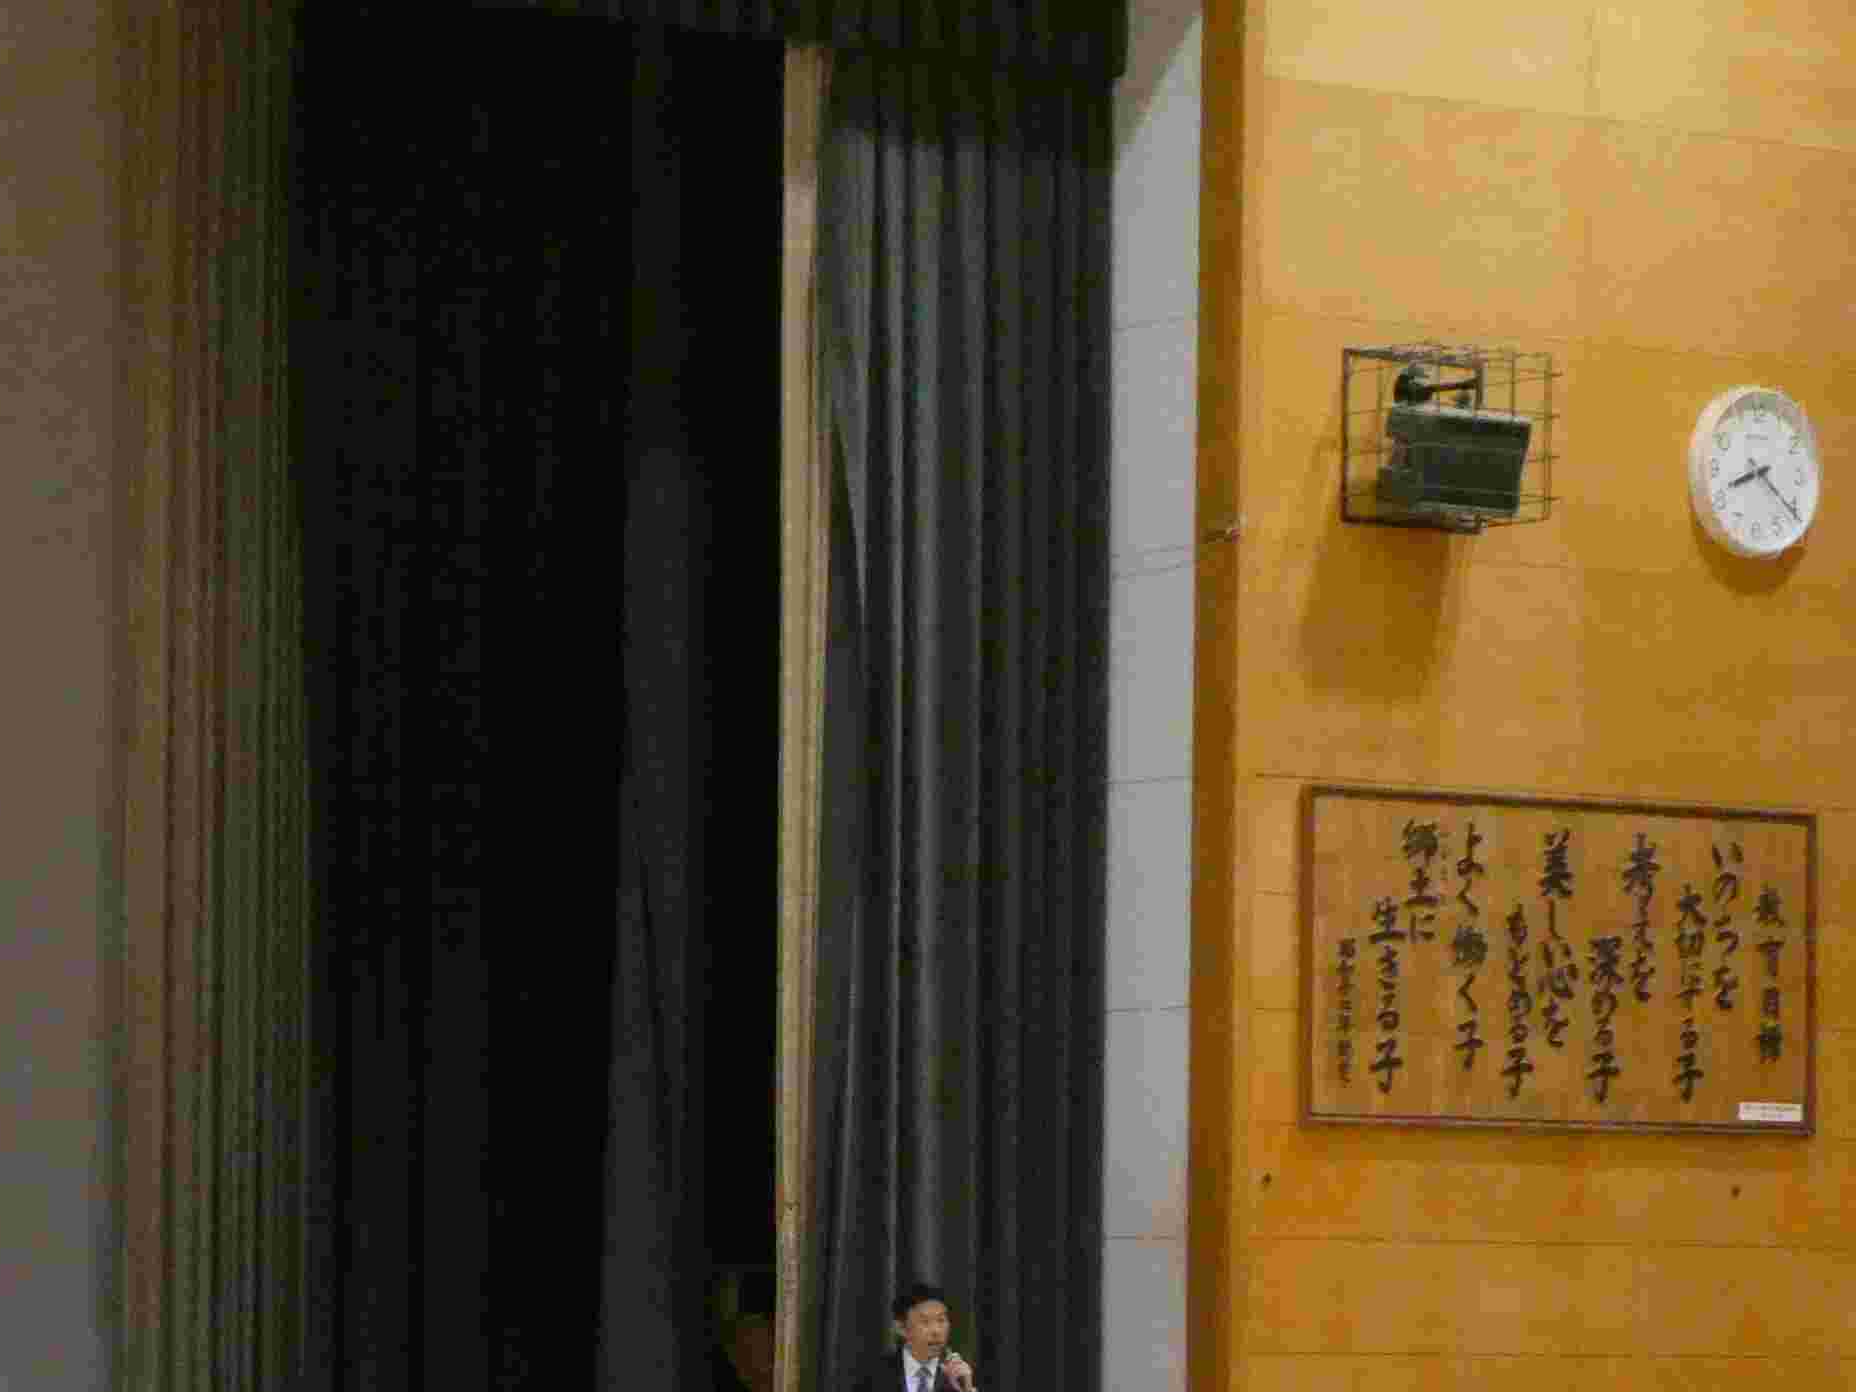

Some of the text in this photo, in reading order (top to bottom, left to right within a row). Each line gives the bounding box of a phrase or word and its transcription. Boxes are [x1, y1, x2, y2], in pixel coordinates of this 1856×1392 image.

[1540, 828, 1578, 1048] 美しい心を
